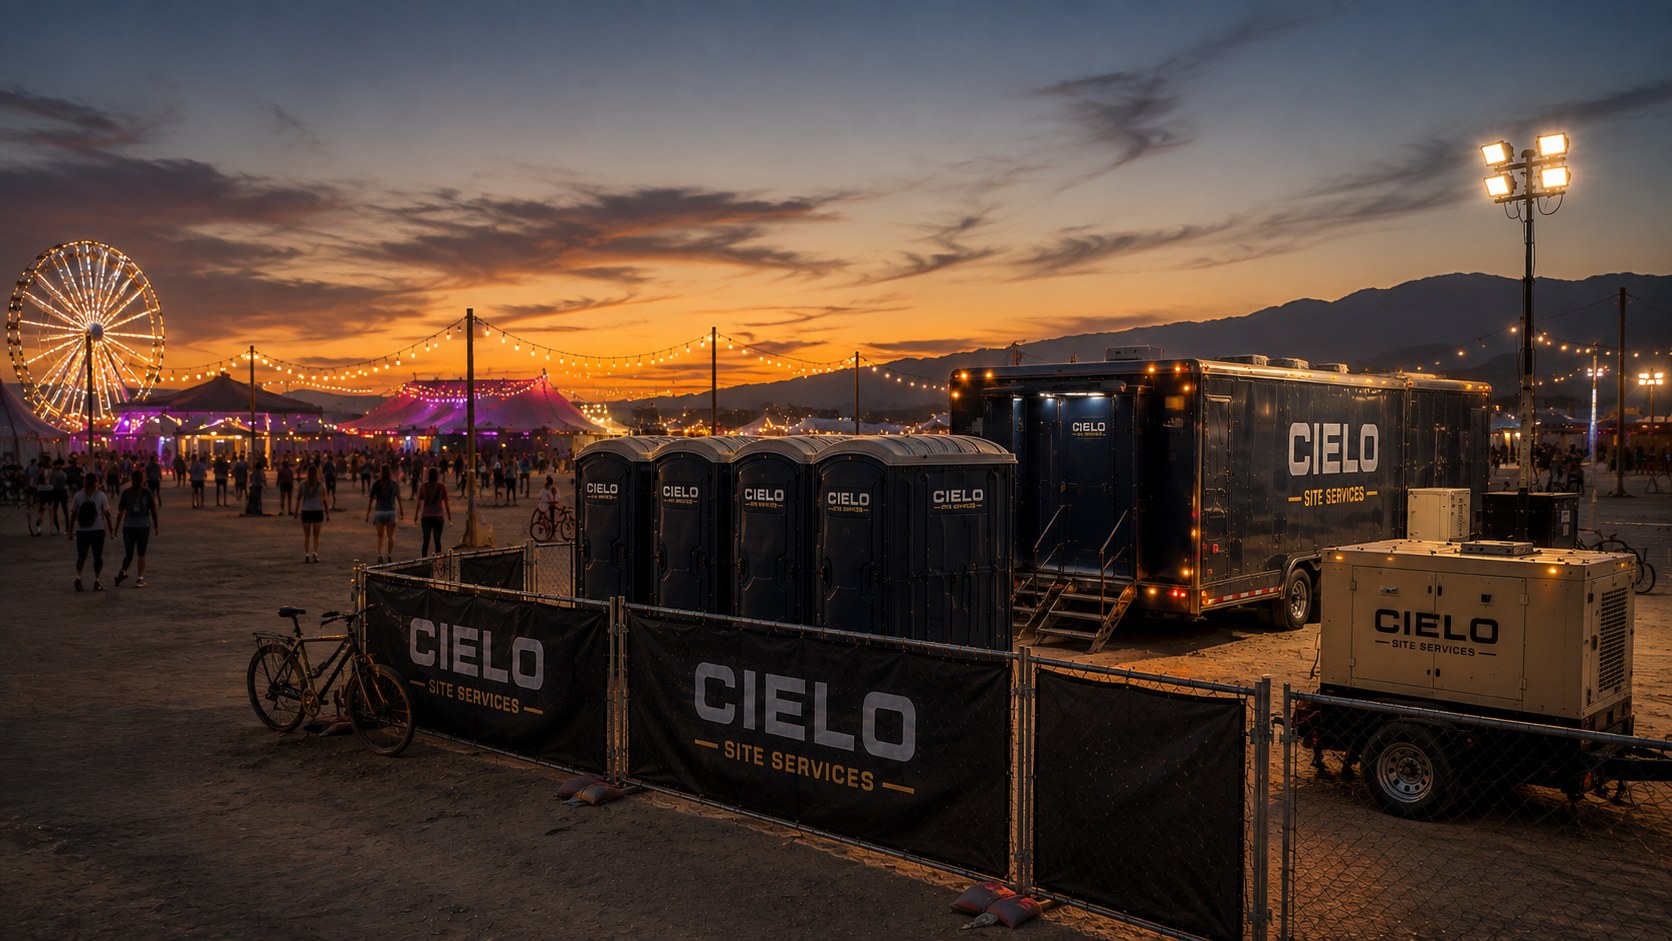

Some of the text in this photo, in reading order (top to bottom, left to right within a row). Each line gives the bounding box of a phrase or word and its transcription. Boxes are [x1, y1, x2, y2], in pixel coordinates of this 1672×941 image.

[1072, 422, 1106, 432] CIELO
[1288, 422, 1379, 476] CIELO
[586, 483, 618, 494] CIELO
[662, 485, 699, 498] CIELO
[744, 488, 785, 502] CIELO
[828, 491, 870, 506] CIELO
[933, 488, 984, 503] CIELO
[1304, 485, 1365, 507] SITE SERVICES
[1374, 608, 1499, 645] CIELO
[409, 617, 544, 691] CIELO
[1392, 639, 1475, 657] SITE SERVICES
[428, 678, 520, 714] SITE SERVICES
[694, 661, 917, 763] CIELO
[724, 739, 875, 792] SITE SERVICES
